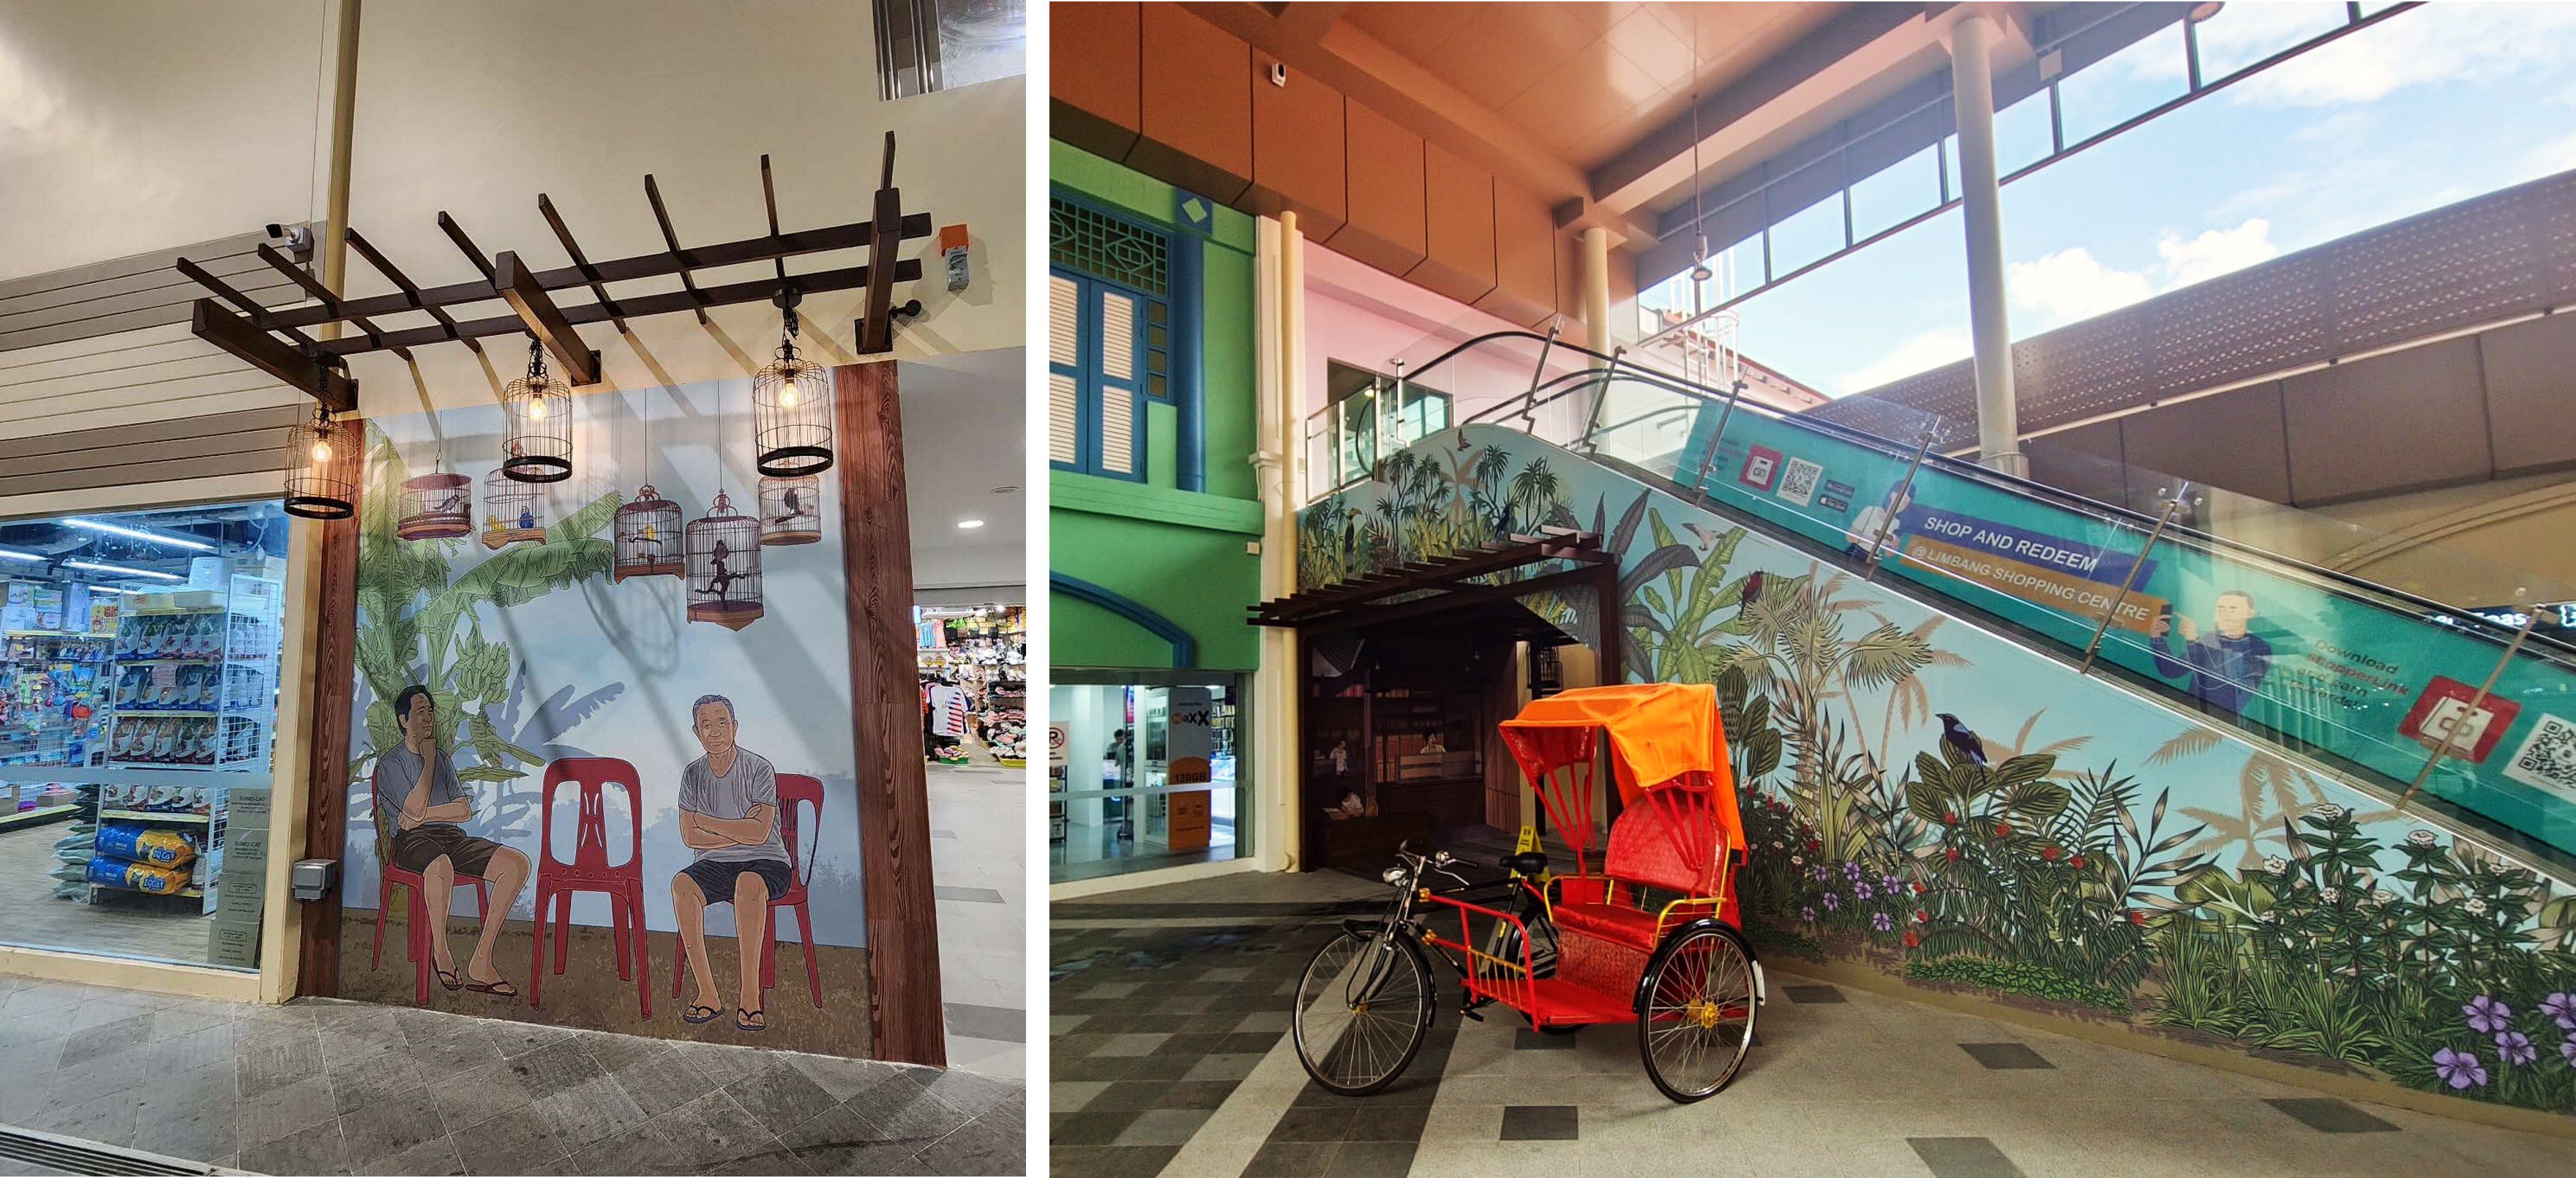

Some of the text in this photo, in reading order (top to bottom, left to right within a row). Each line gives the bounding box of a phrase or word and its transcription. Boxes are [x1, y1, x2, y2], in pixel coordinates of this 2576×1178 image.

[1924, 517, 2097, 572] SHOP AND REDEEM
[1912, 546, 2150, 621] @ LIMBANG SHOPPING CENTRE
[2315, 639, 2400, 675] Download
[2332, 679, 2368, 697] earn
[1174, 772, 1207, 784] 130GB
